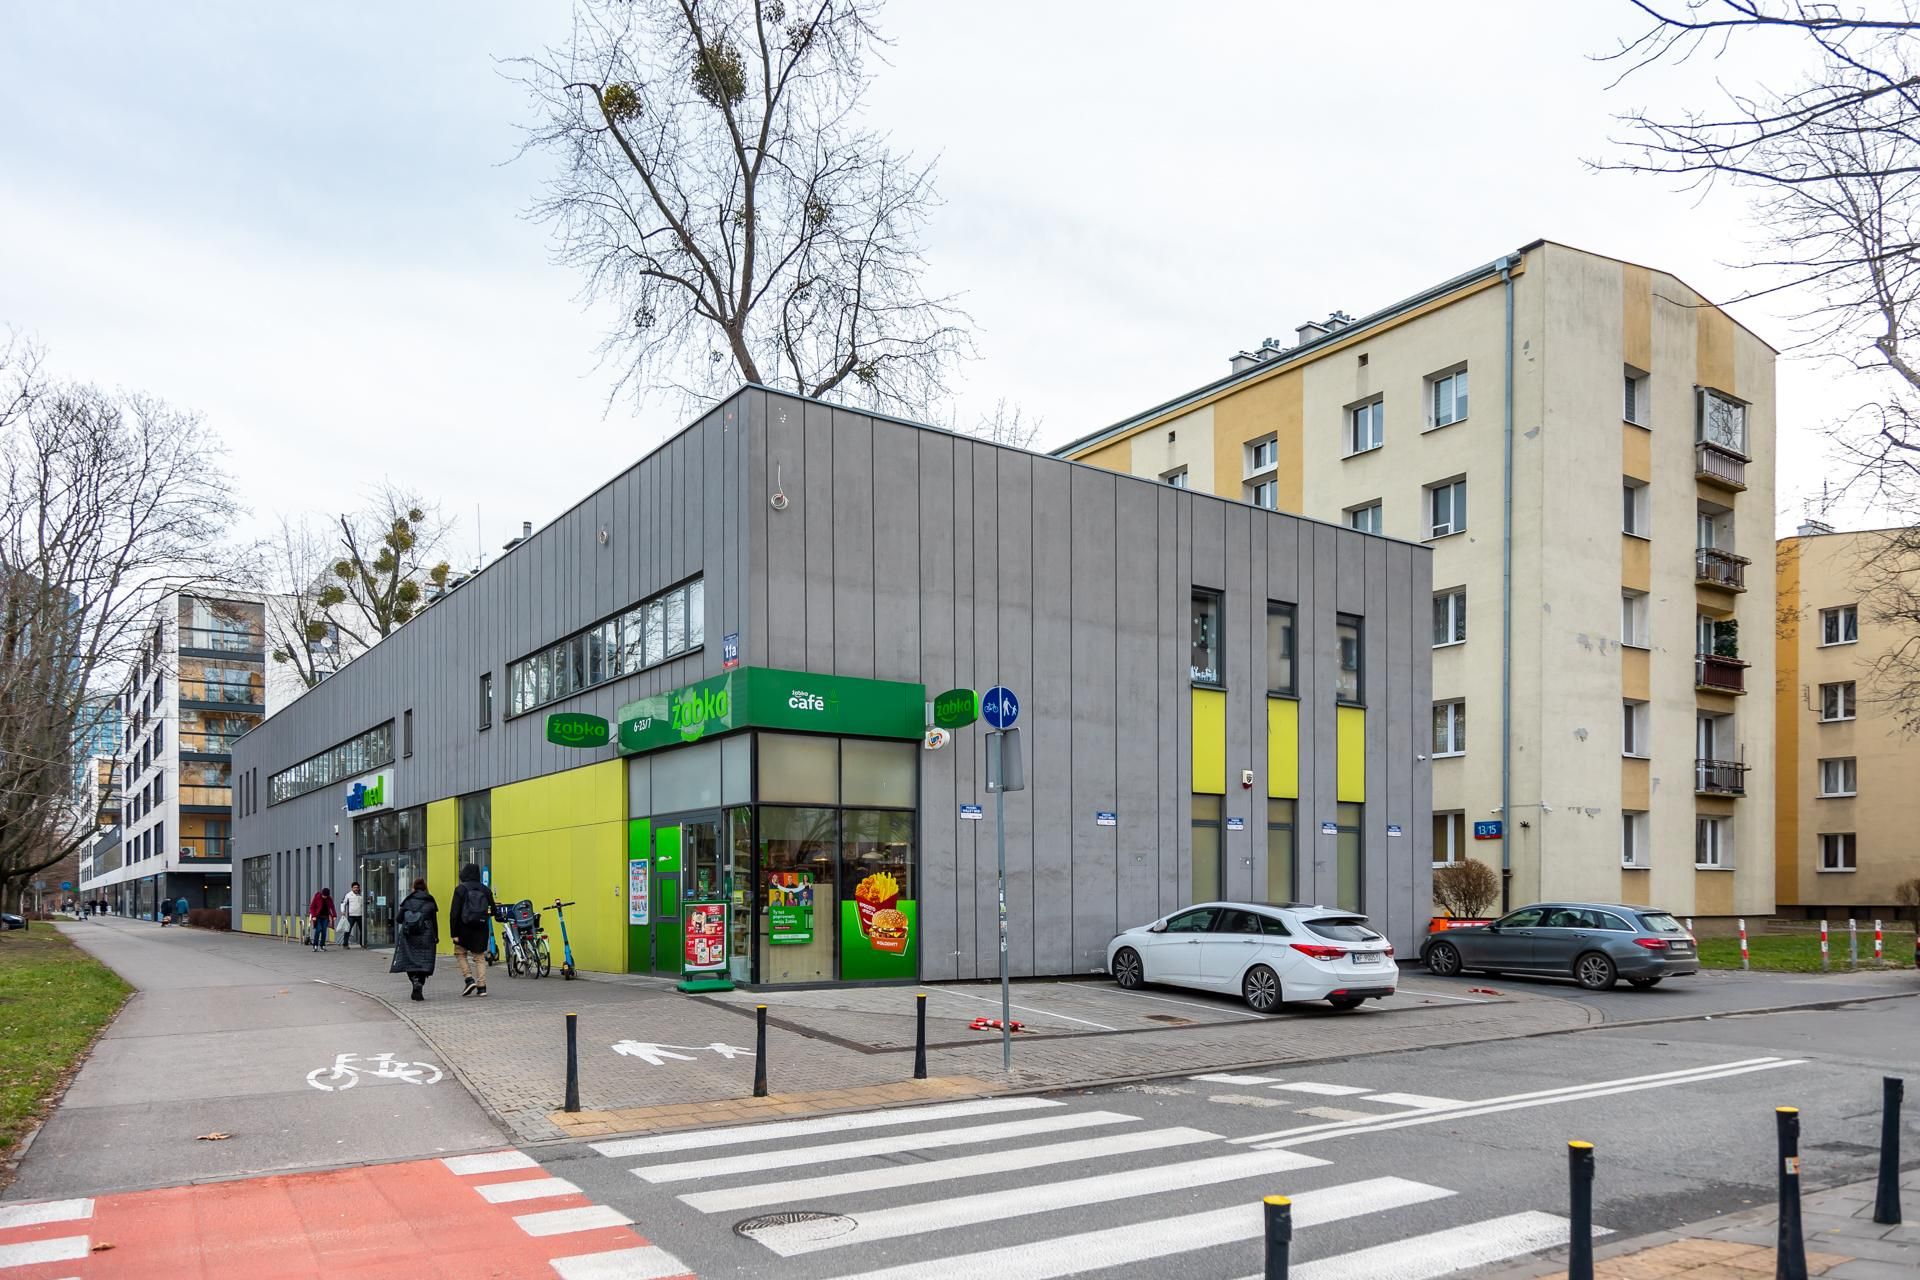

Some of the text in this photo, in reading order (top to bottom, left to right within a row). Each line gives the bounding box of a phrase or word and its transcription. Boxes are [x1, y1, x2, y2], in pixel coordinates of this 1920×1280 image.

[724, 643, 737, 659] 11a
[671, 687, 728, 730] żabka
[788, 694, 824, 711] café
[936, 698, 971, 717] żabka
[553, 719, 605, 737] żabka
[633, 718, 652, 733] 6-23/7
